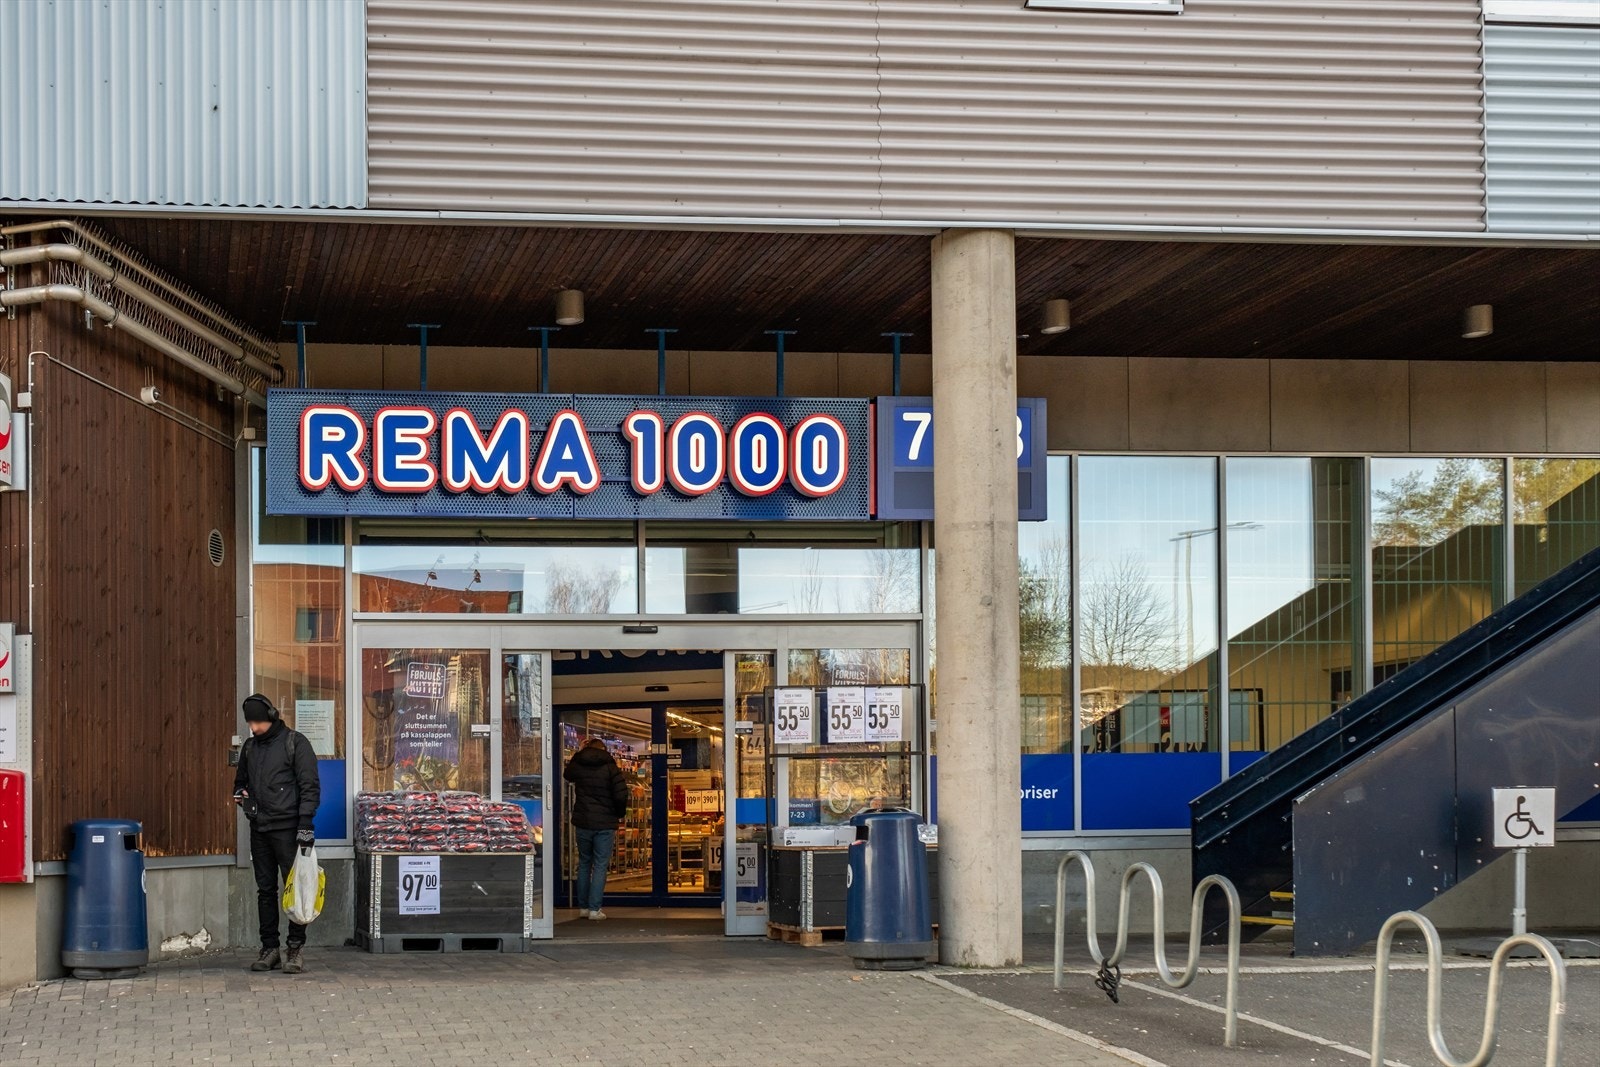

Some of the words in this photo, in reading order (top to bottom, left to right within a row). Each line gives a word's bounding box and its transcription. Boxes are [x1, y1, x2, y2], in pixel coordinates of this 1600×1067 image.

[300, 404, 601, 495] REMA
[623, 411, 849, 497] 1000
[410, 681, 442, 694] KUTTET
[401, 731, 410, 739] på
[411, 731, 451, 739] kassalappen
[790, 811, 805, 819] 7-23
[402, 874, 424, 901] 97
